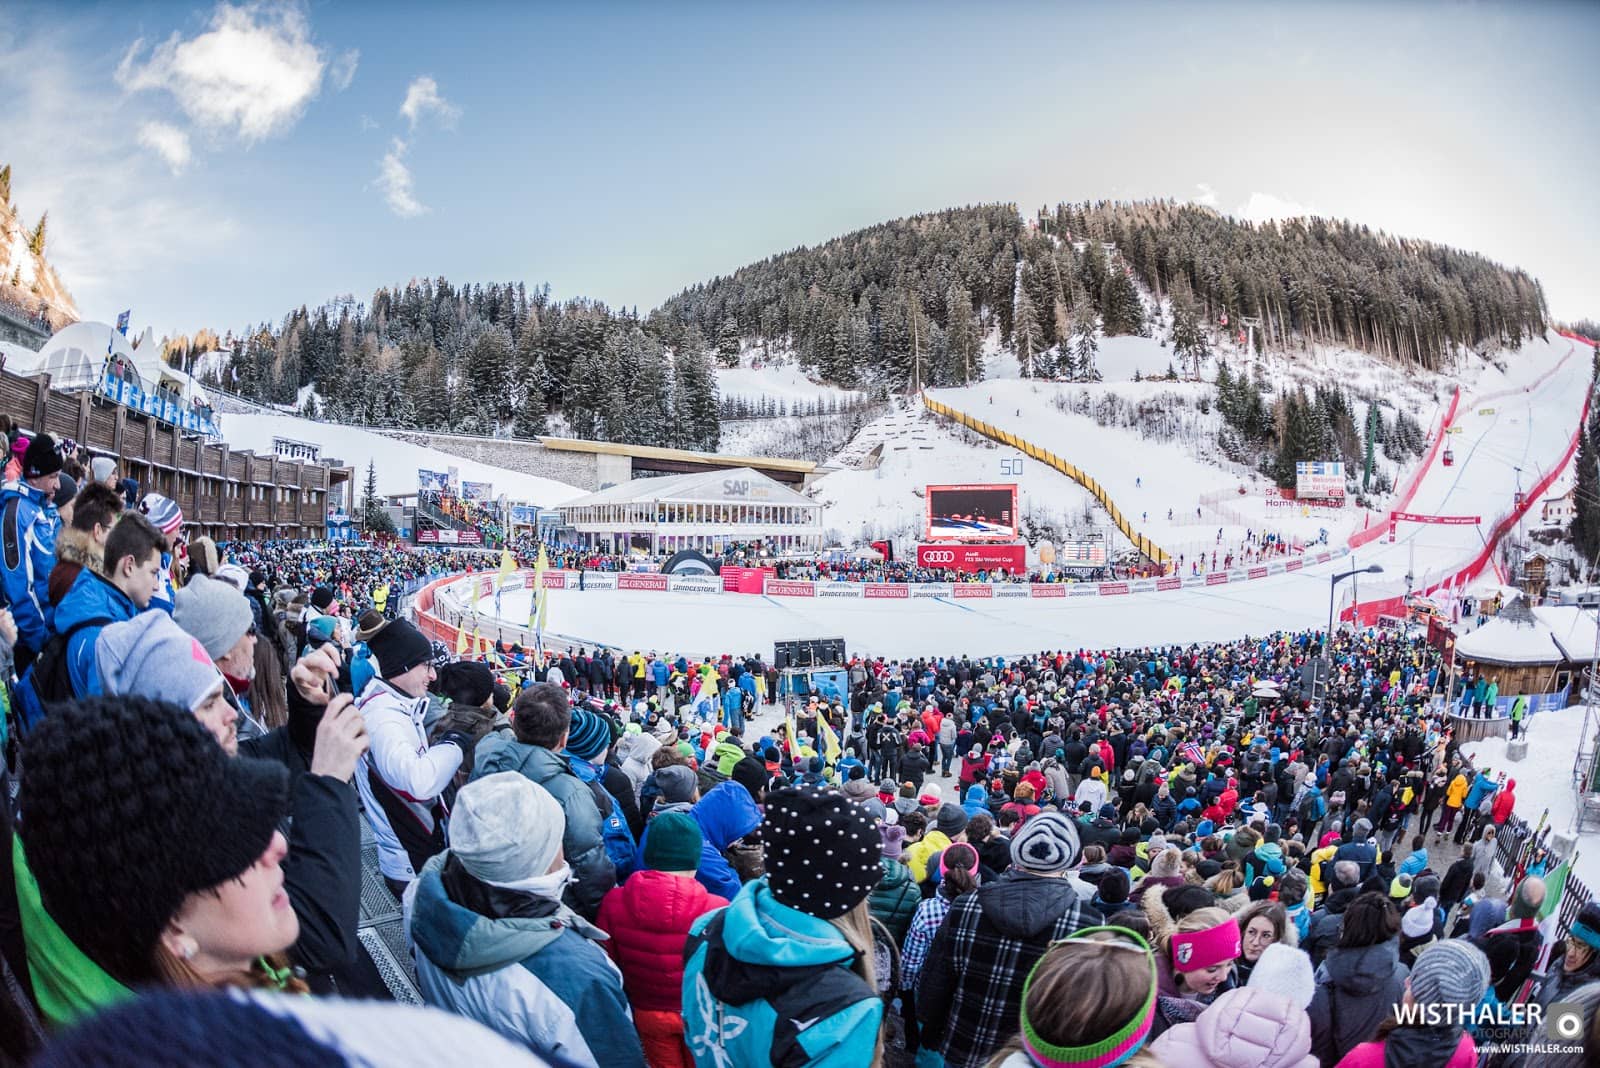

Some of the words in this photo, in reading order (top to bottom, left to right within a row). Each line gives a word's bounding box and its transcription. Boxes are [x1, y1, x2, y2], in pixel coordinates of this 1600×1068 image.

[1000, 459, 1023, 475] 50
[723, 480, 748, 496] SAP
[543, 578, 564, 586] ERALI
[629, 580, 666, 588] GENERALI
[673, 584, 716, 592] BRIDGESTONE
[778, 586, 813, 595] GENERALI
